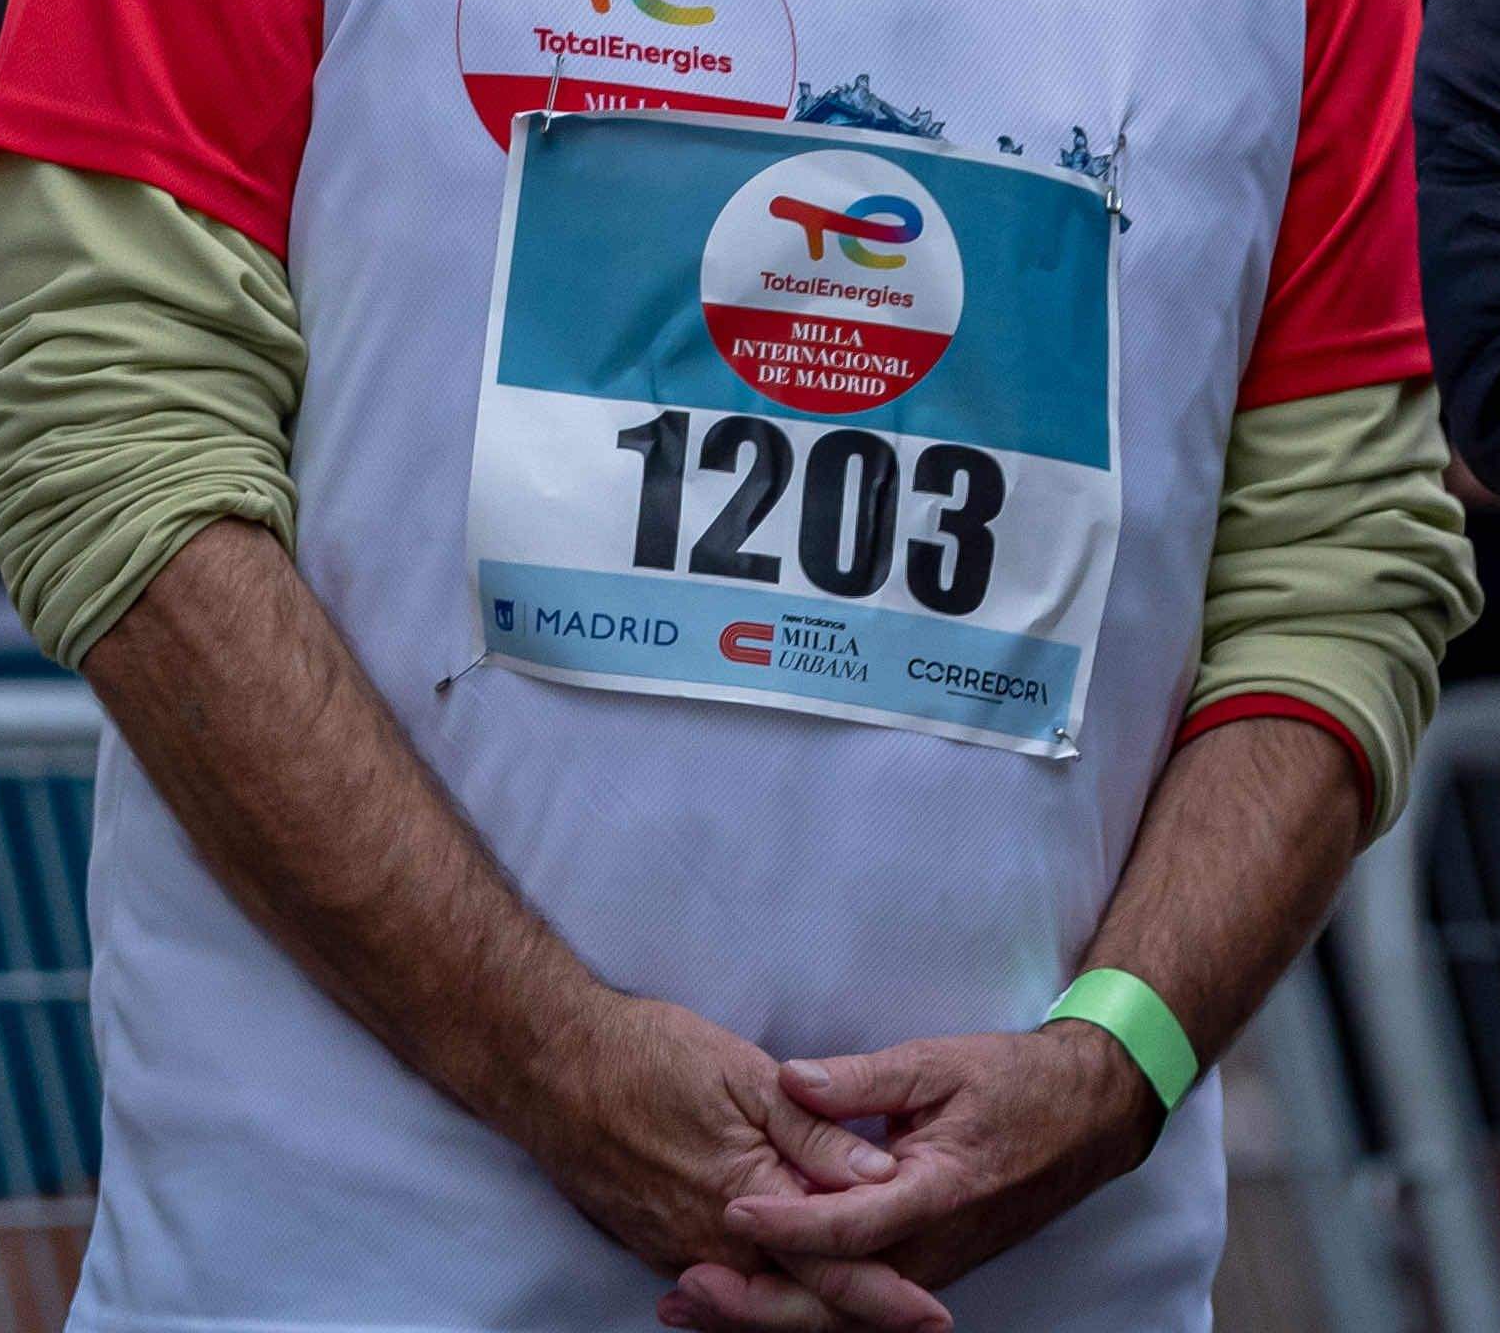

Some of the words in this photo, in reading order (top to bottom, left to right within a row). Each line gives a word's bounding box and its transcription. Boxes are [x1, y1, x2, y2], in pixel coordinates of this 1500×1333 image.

[533, 27, 733, 75] TotalEnergies
[760, 271, 915, 309] TotalEnergies
[791, 321, 864, 348] MILLA
[757, 364, 790, 385] DE
[795, 368, 887, 396] MADRID
[617, 410, 1007, 617] 1203
[535, 606, 680, 647] MADRID
[781, 627, 860, 657] MILLA
[778, 650, 869, 683] URBANA
